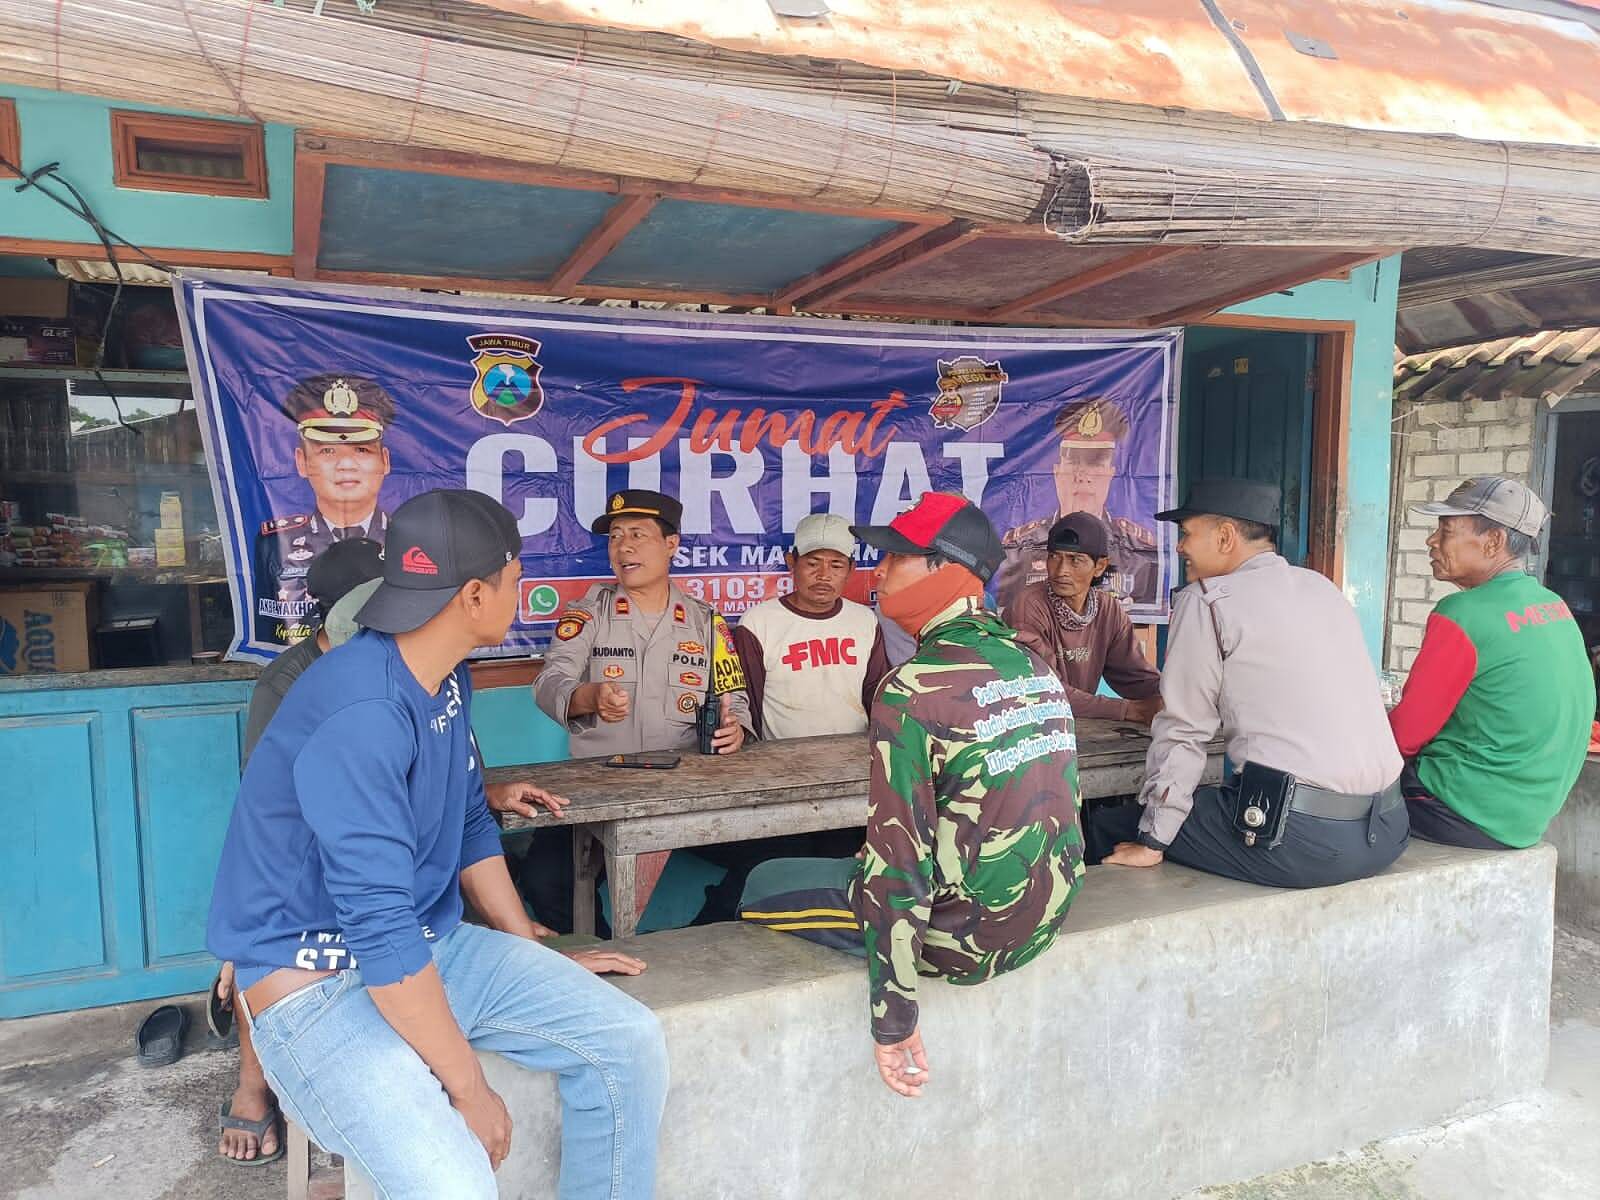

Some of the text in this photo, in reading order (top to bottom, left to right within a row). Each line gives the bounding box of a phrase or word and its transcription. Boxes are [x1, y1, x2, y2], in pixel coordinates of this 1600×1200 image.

[504, 339, 530, 349] TIMUR
[582, 376, 909, 464] Jumat
[465, 433, 1006, 537] CURHAT
[672, 546, 729, 568] SEK
[686, 576, 766, 601] 3103
[592, 646, 634, 658] SUDIANTO
[672, 653, 707, 668] POLRI
[782, 636, 858, 672] FMC
